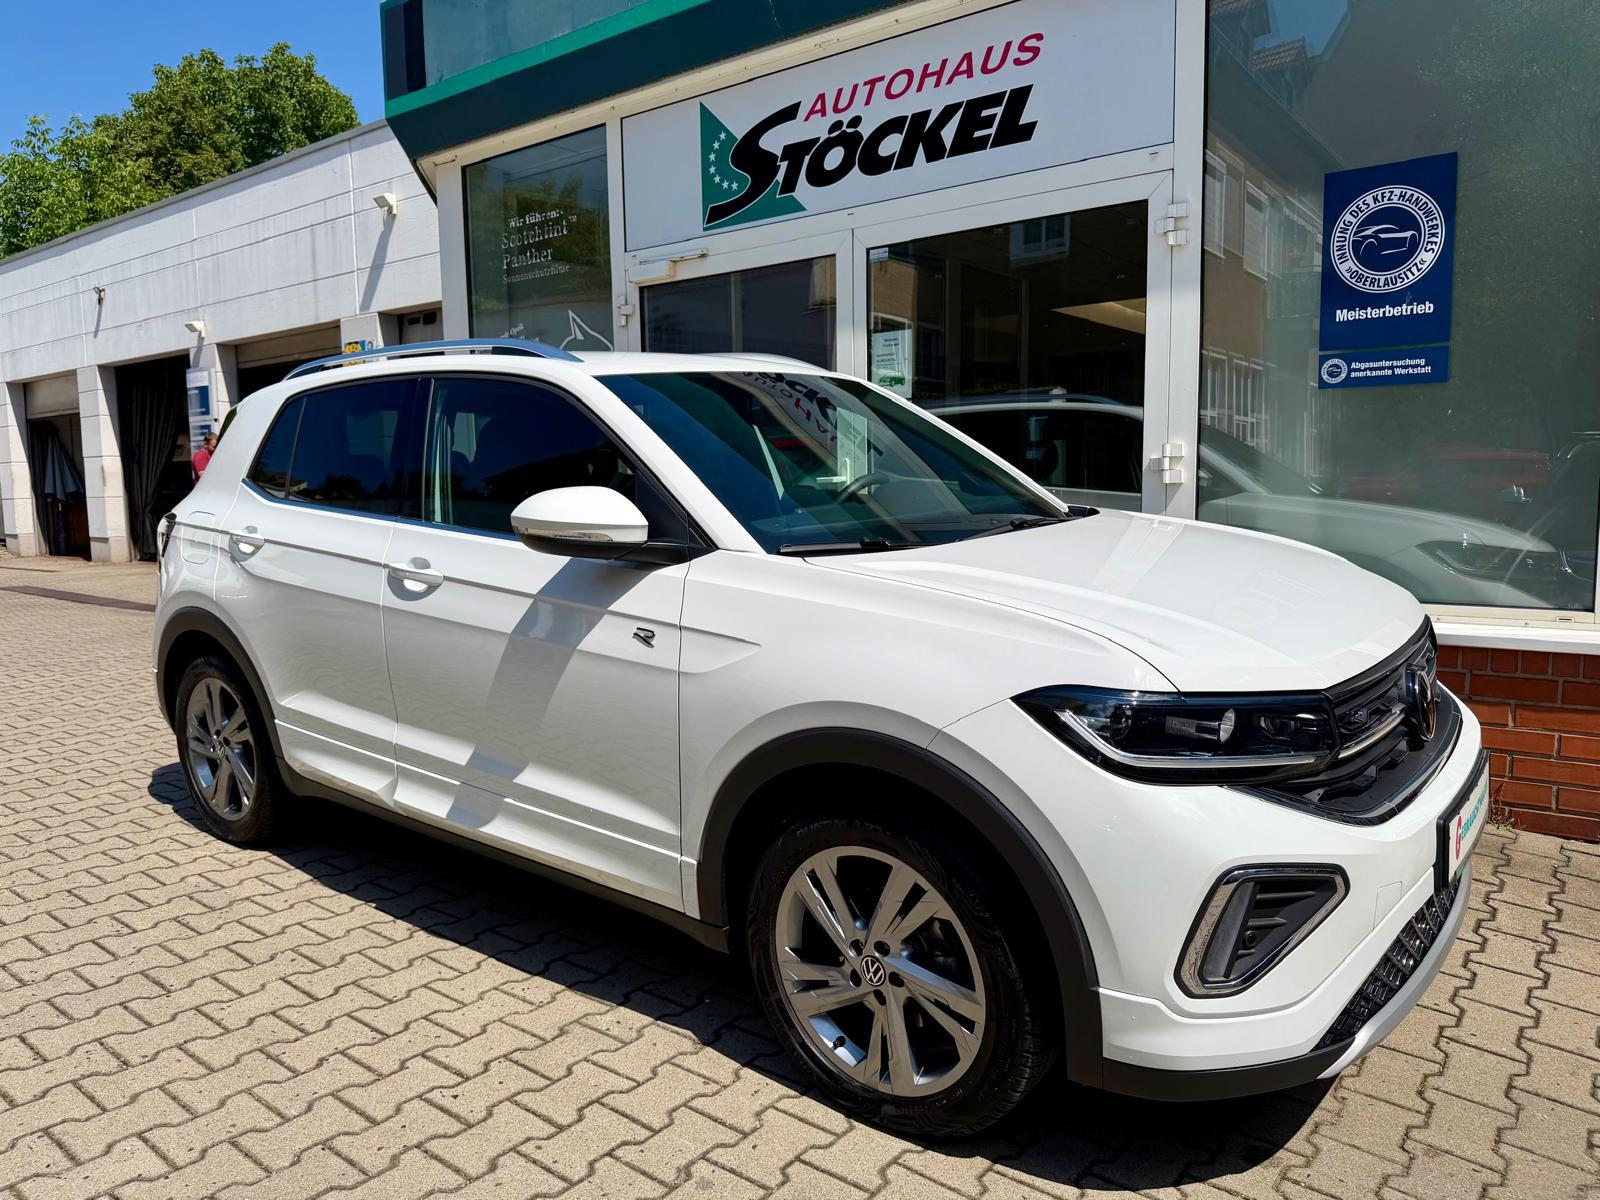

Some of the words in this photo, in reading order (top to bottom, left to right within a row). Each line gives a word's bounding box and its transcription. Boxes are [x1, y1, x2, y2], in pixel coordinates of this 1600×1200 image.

[803, 32, 1045, 122] AUTOHAUS
[704, 83, 1038, 226] STÖCKEL
[508, 216, 524, 228] Wir
[1335, 218, 1353, 265] INNUNG
[1350, 198, 1371, 220] DES
[1372, 190, 1440, 254] KFZ-HANDWERKES
[502, 248, 553, 269] Panther
[1335, 301, 1434, 322] Meisterbetrieb
[1350, 358, 1426, 369] Abgasuntersuchung
[1350, 368, 1393, 378] anerkannte
[1394, 366, 1432, 375] Werkstatt
